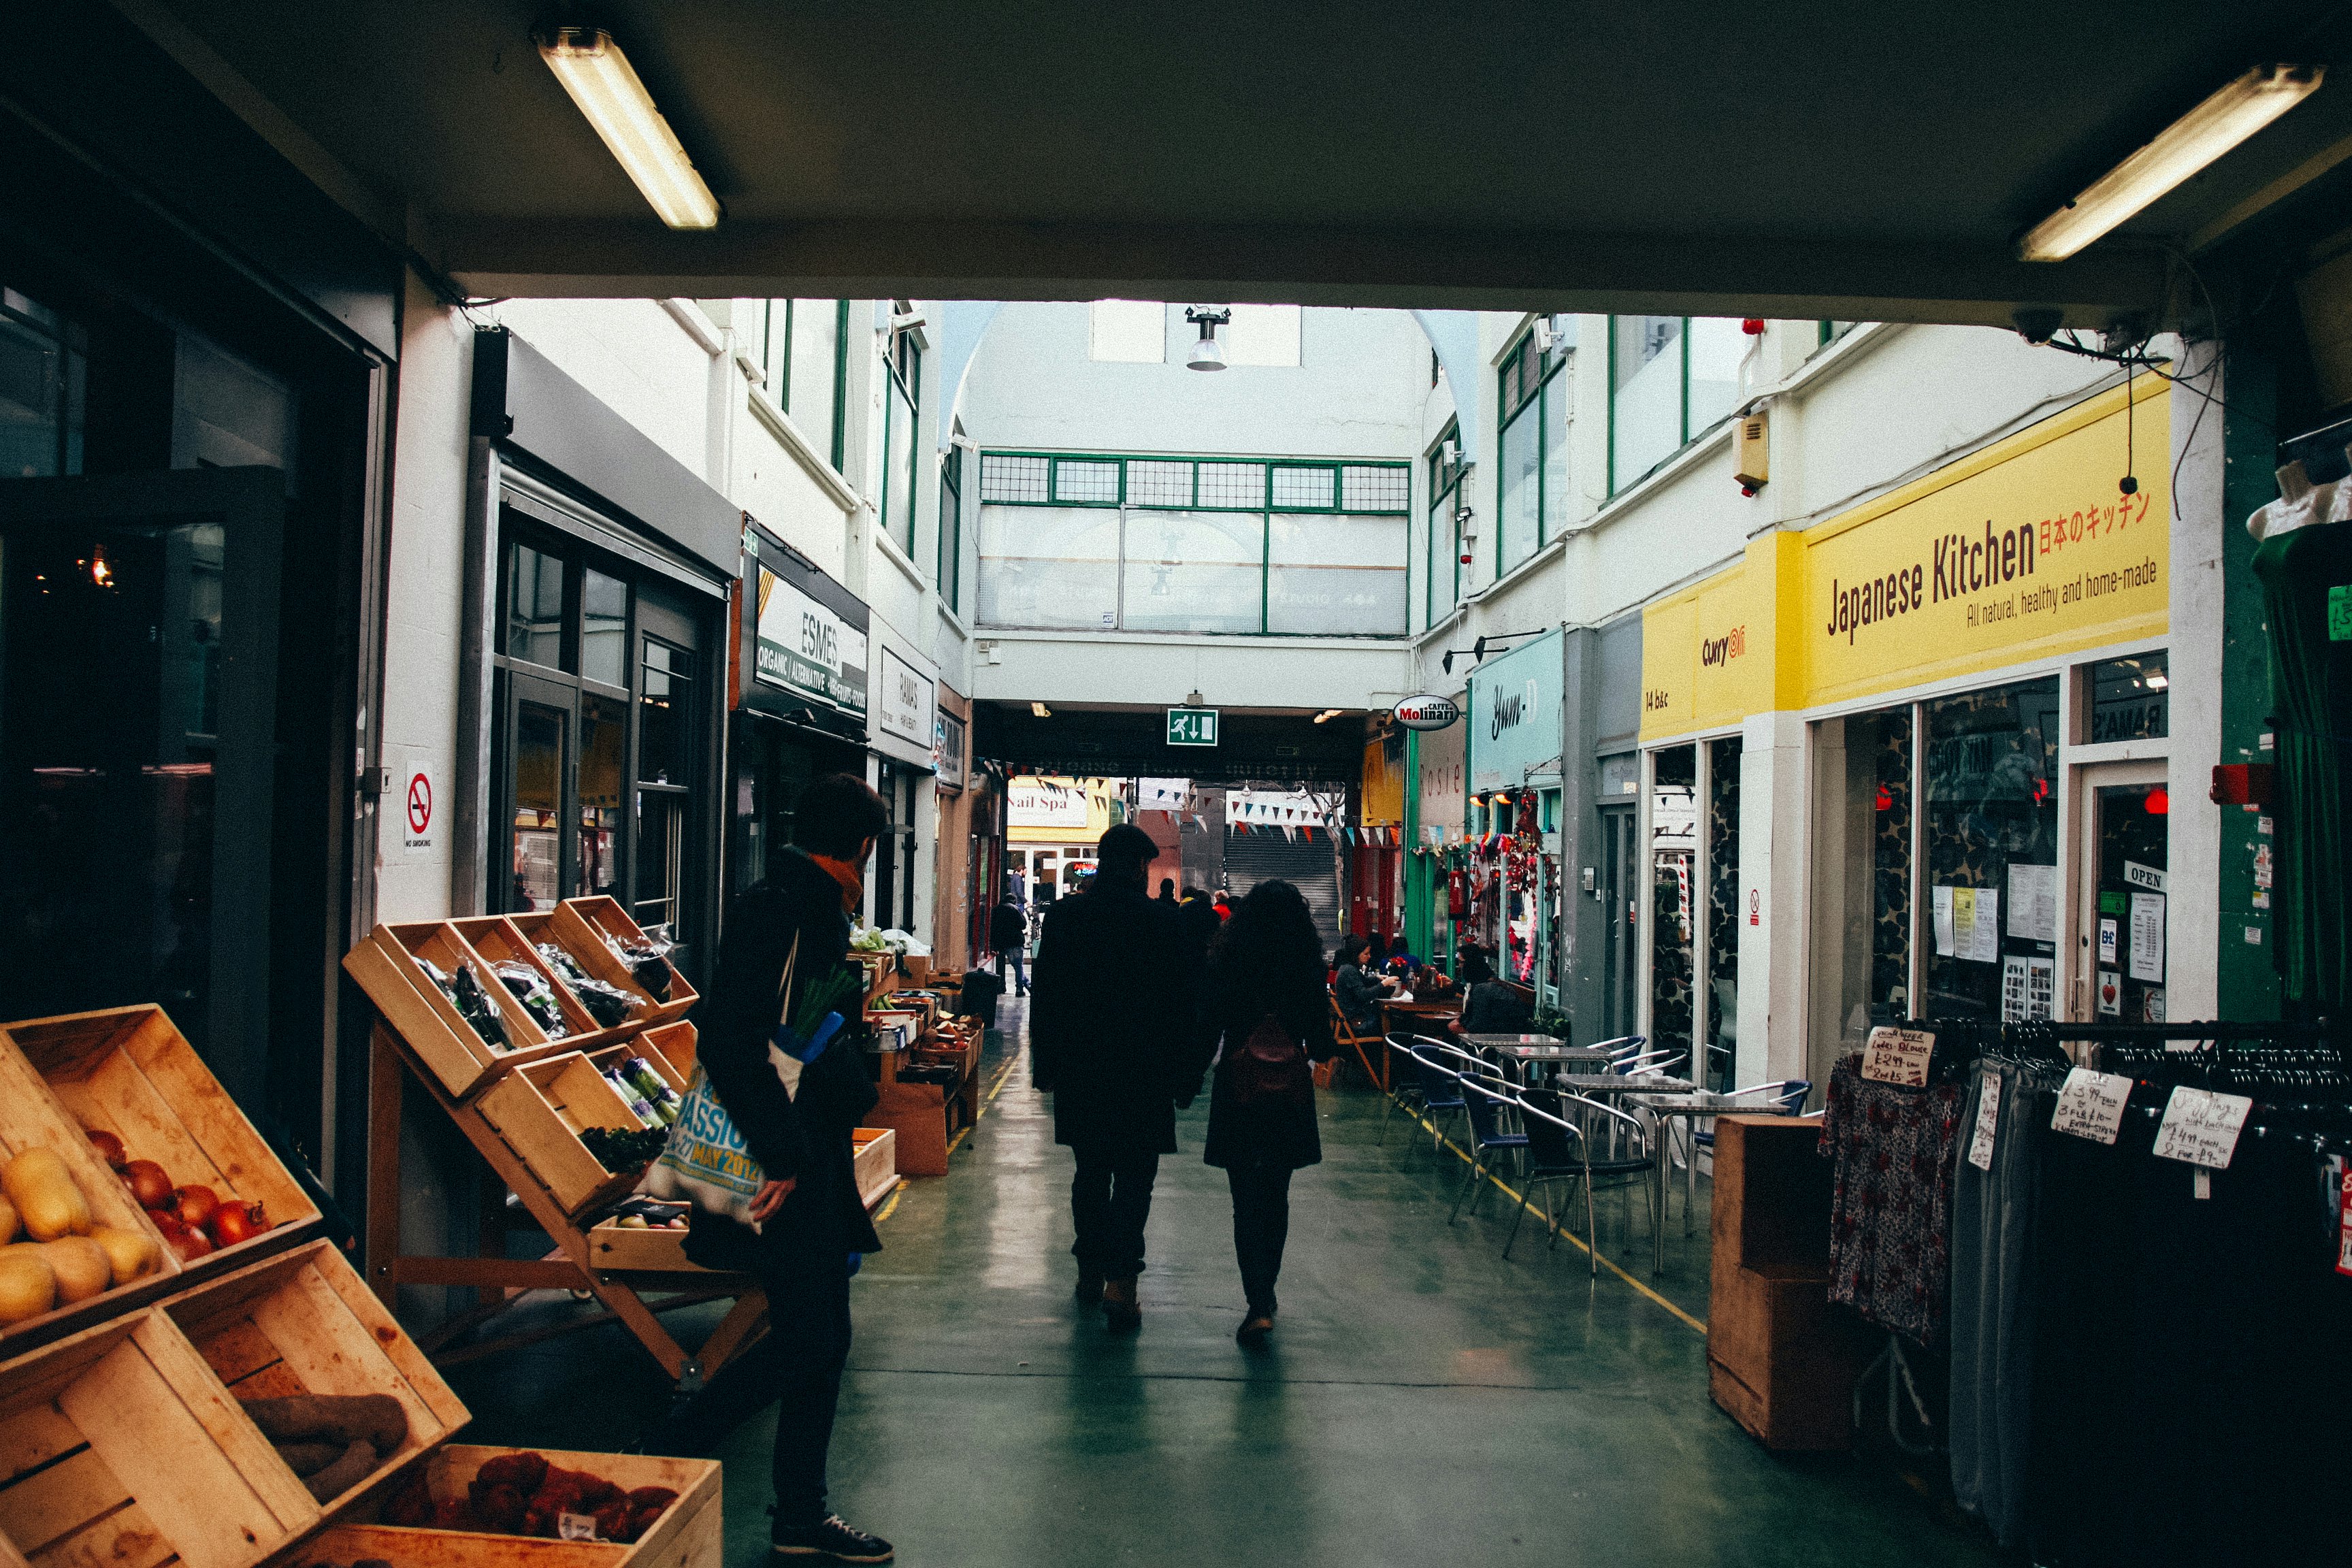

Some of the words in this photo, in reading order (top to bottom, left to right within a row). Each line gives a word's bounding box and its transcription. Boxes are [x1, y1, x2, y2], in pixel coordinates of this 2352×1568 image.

[2040, 492, 2150, 556] 日本のキッチン
[1827, 564, 1923, 646] Japanese
[1933, 519, 2034, 604] Kitchen
[1967, 604, 1980, 628] All
[1982, 593, 2018, 625] natural,
[2021, 583, 2058, 615] healthy
[2062, 574, 2081, 604] and
[2086, 555, 2157, 599] home-made
[802, 611, 838, 667] ESMES
[758, 645, 788, 676] ORGANIC
[791, 660, 826, 691] ALTERNATIVE
[1399, 706, 1454, 721] Molinari
[1646, 691, 1653, 712] 14
[1039, 796, 1067, 811] Spa
[412, 839, 431, 847] SMOKING
[2131, 867, 2161, 888] OPEN
[2058, 1105, 2069, 1115] 3
[691, 1142, 723, 1170] MAY
